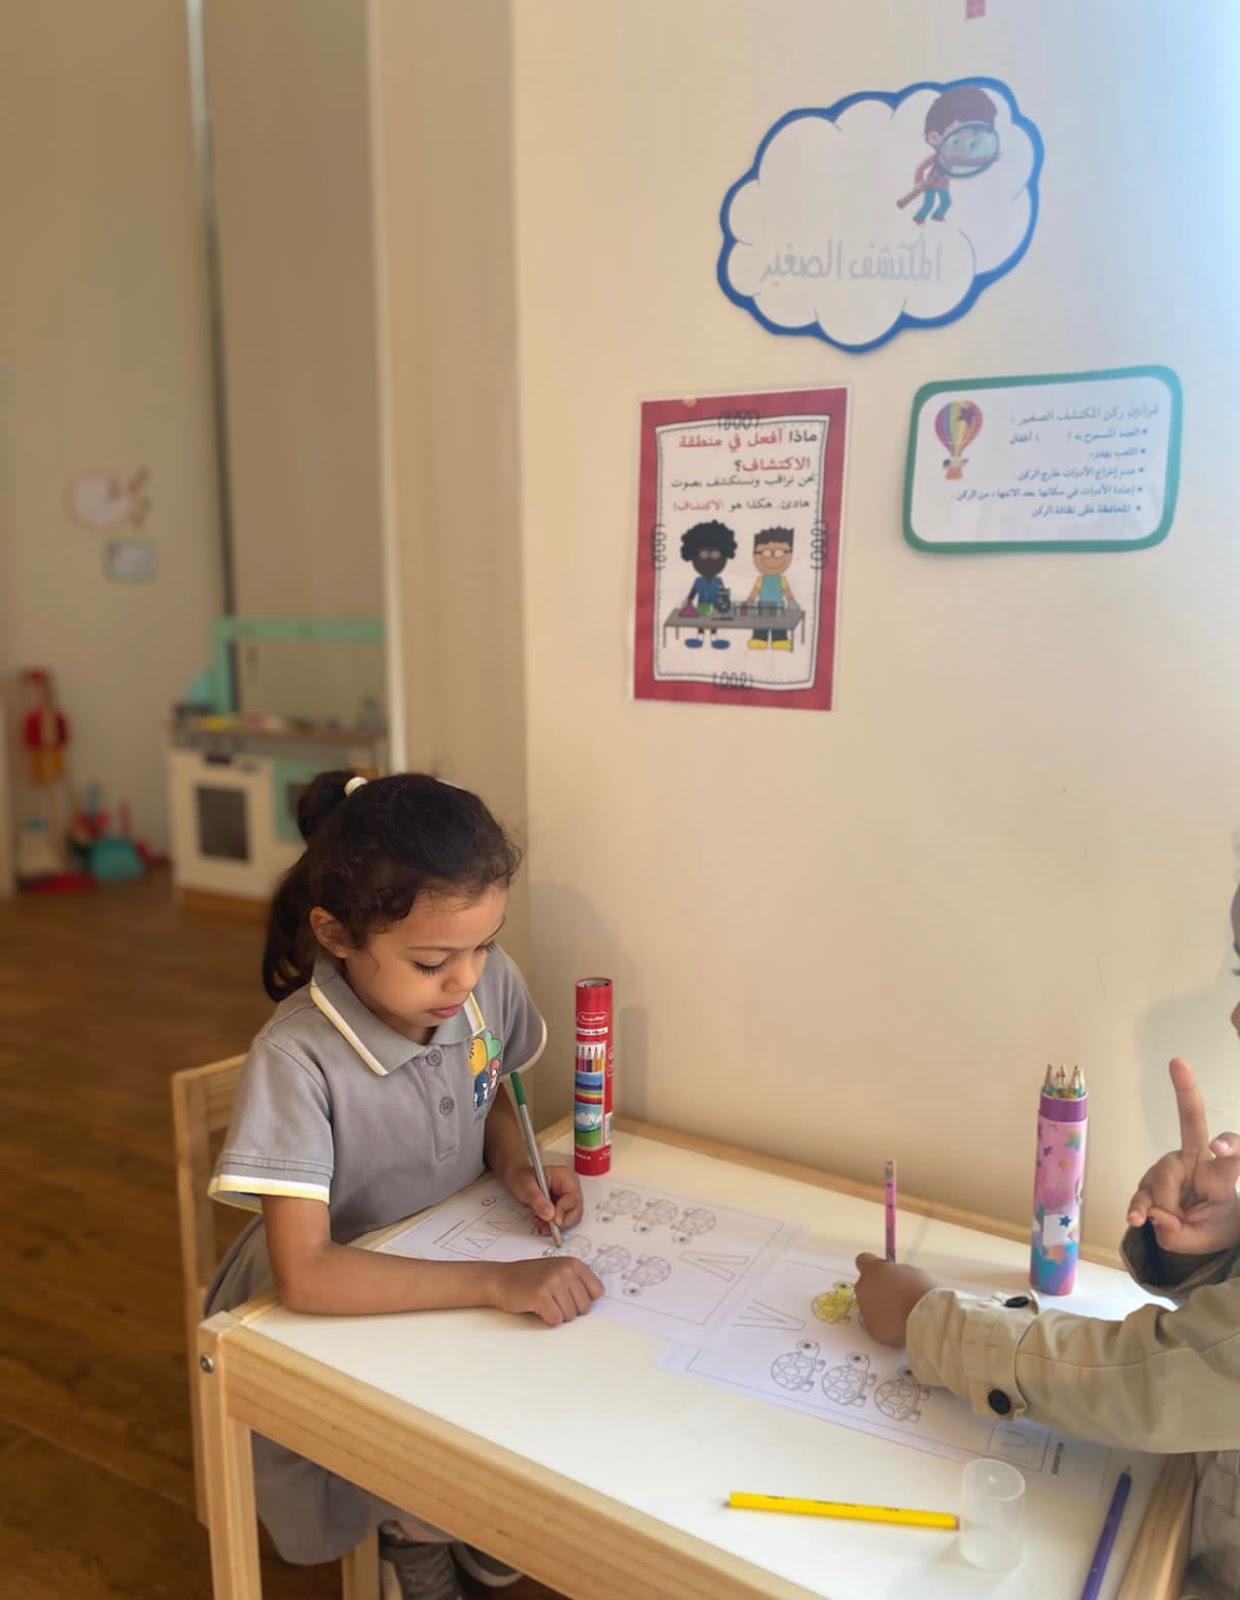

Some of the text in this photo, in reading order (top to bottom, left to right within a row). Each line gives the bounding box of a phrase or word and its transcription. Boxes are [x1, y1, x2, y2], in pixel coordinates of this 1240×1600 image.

[760, 233, 943, 287] المكتشف الصغير
[1018, 410, 1055, 426] الصغير
[1103, 405, 1125, 421] ركن
[679, 428, 818, 452] ماذا أفعل في منطقة
[671, 480, 702, 490] بصوت
[729, 501, 742, 513] هو
